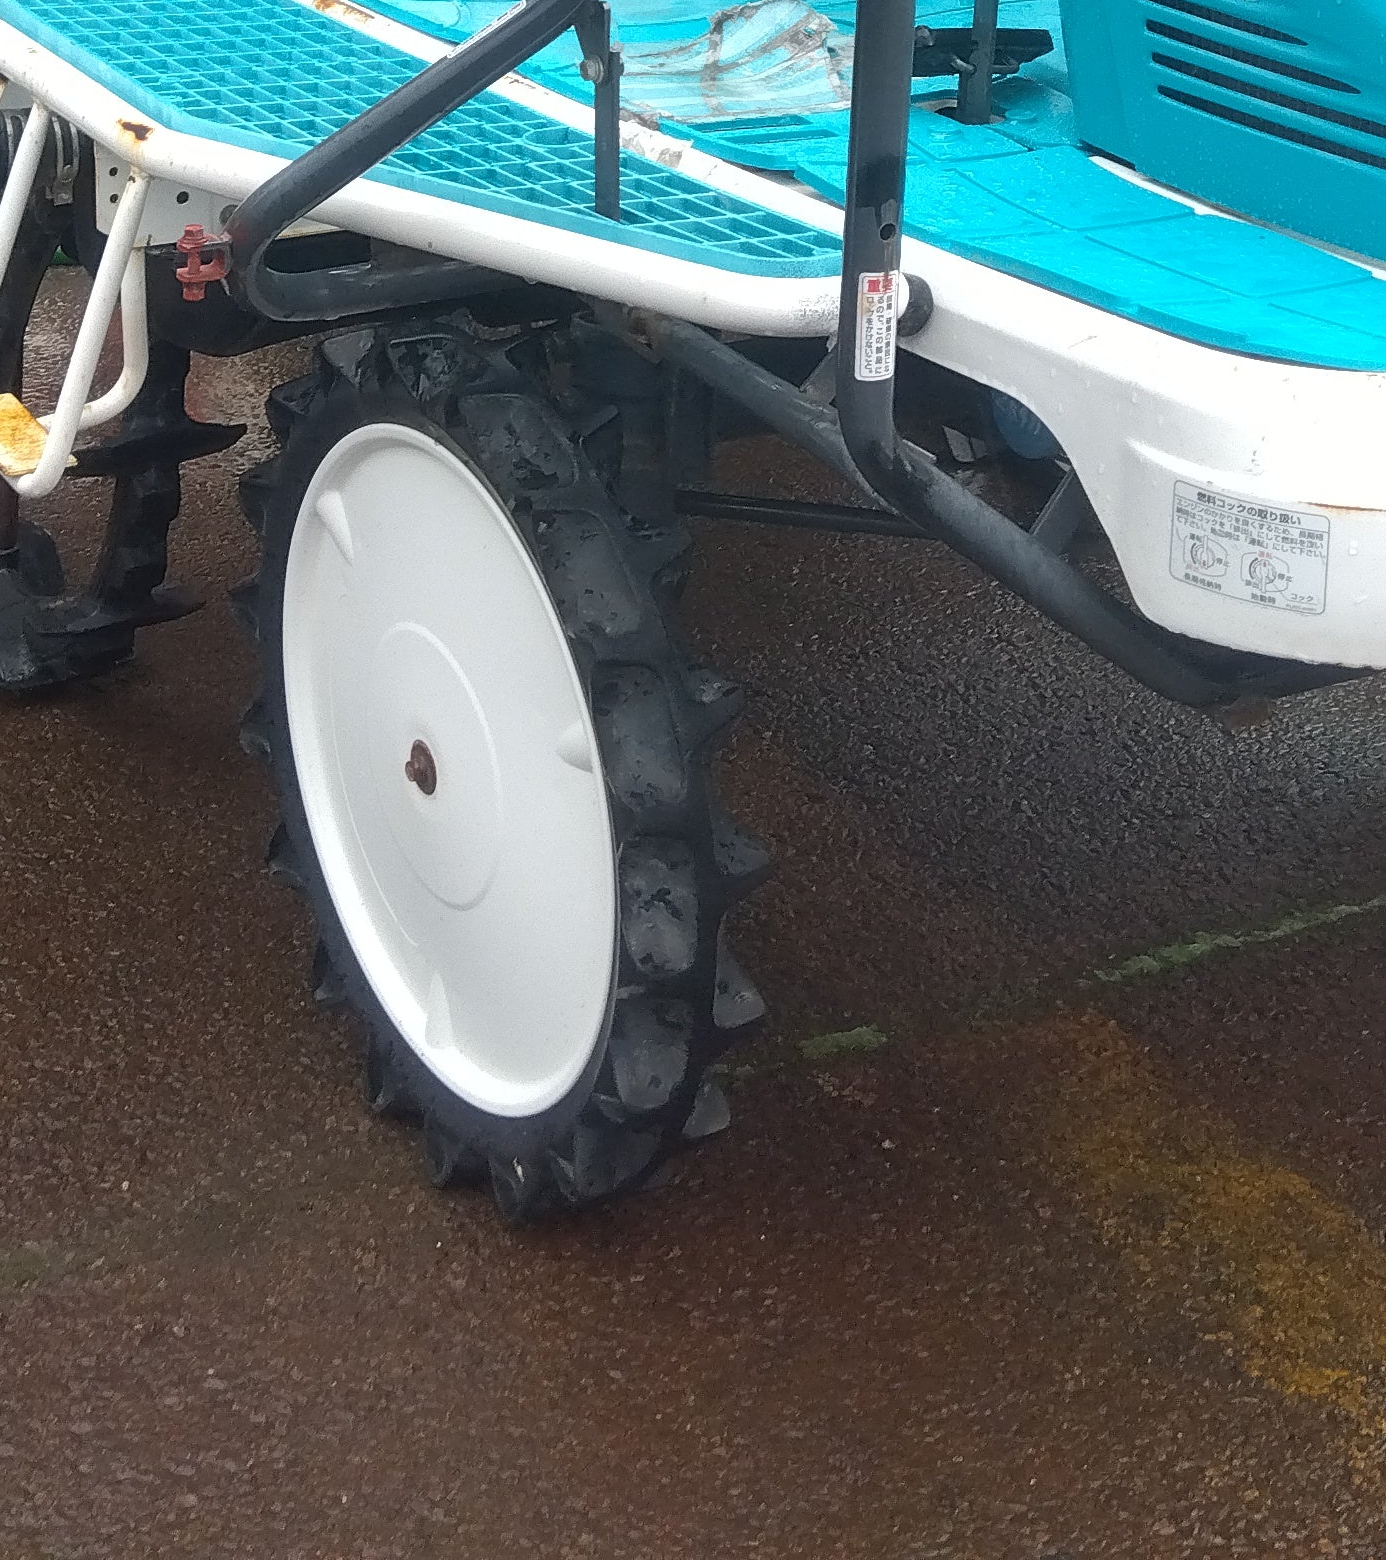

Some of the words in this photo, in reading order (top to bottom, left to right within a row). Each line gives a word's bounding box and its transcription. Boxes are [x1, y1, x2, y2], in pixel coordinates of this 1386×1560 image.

[1197, 492, 1302, 525] 燃料コックの取り扱い
